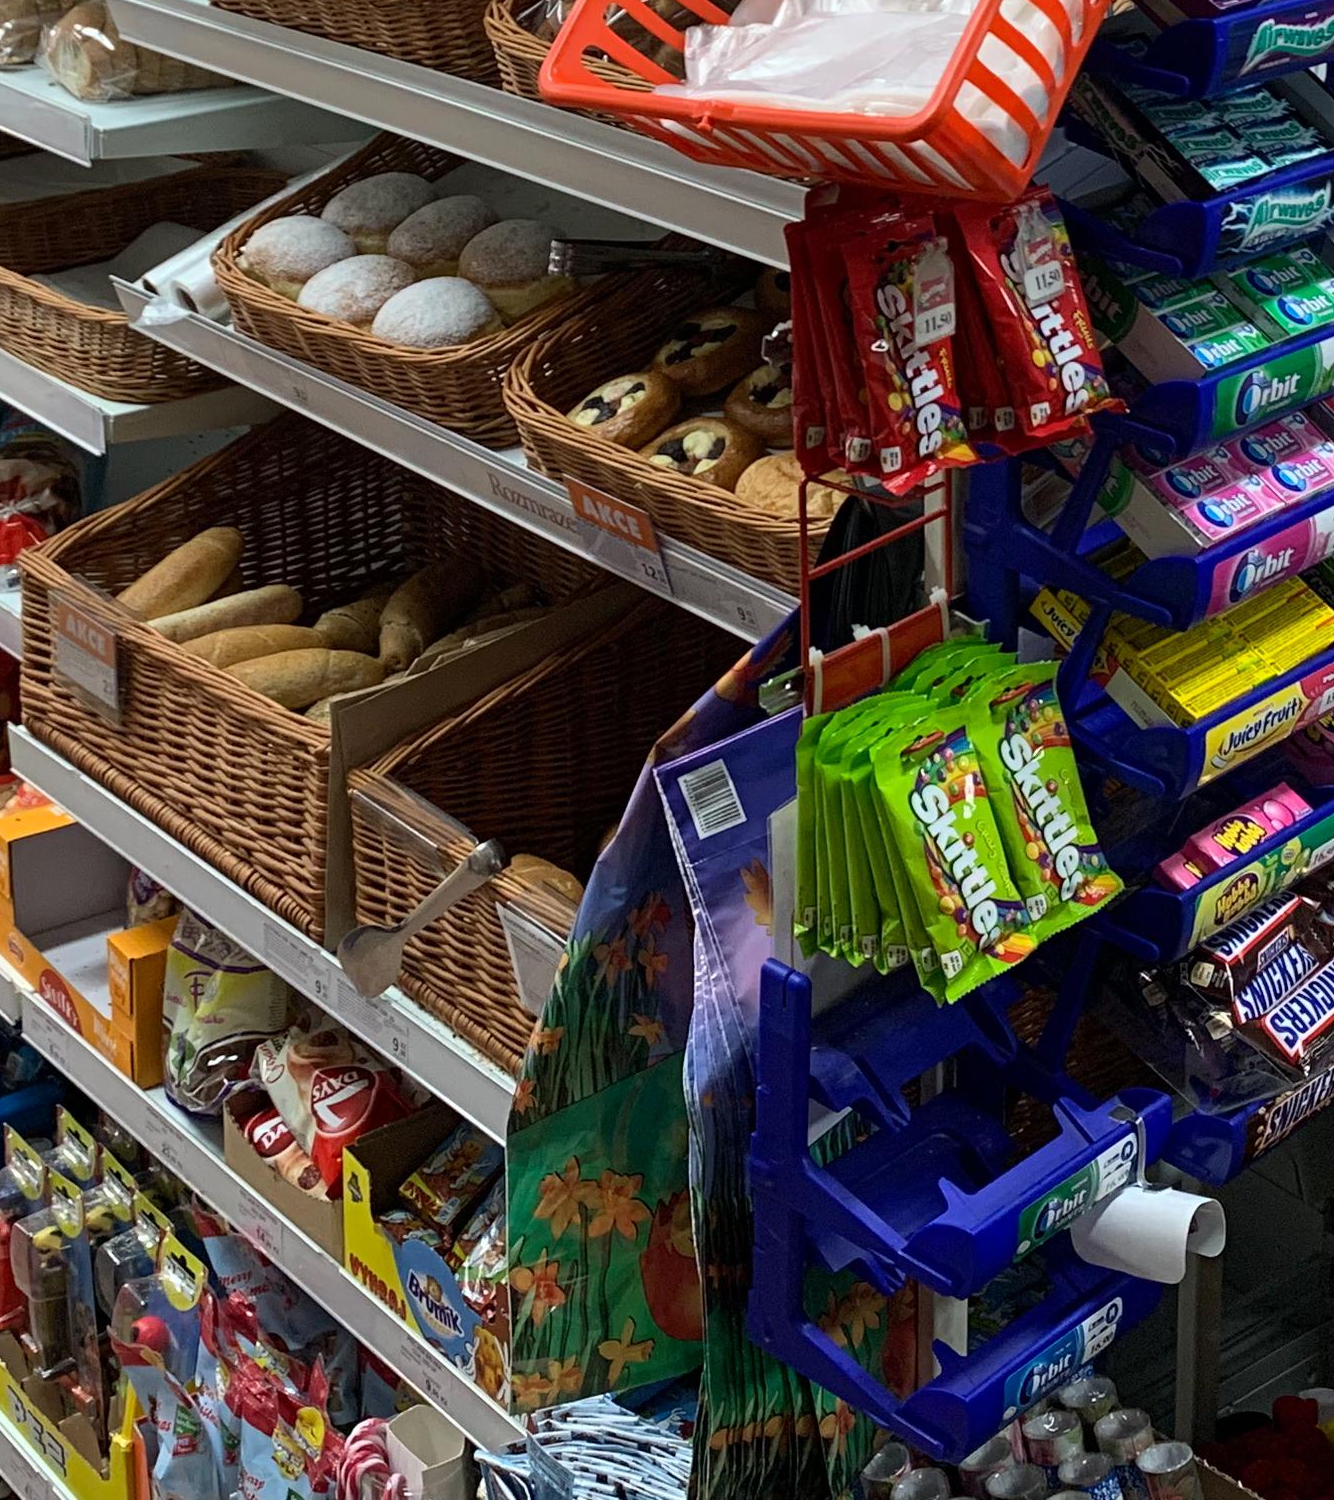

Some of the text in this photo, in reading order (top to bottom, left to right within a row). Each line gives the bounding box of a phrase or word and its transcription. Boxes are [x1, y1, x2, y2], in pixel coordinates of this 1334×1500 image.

[1250, 188, 1330, 229] Airwaves
[1247, 264, 1305, 296] Orbit
[1276, 293, 1334, 326] Orbit
[1235, 372, 1302, 427] Orbit
[1270, 457, 1327, 494] Orbit
[486, 471, 578, 536] Rozmraze
[581, 493, 642, 541] AKCE
[1197, 492, 1252, 530] Orbit
[1231, 545, 1293, 603] Orbit
[63, 615, 111, 663] AKCE
[1000, 732, 1085, 903] Skittles
[911, 783, 1002, 949] Skittles
[406, 1268, 466, 1338] Brumík
